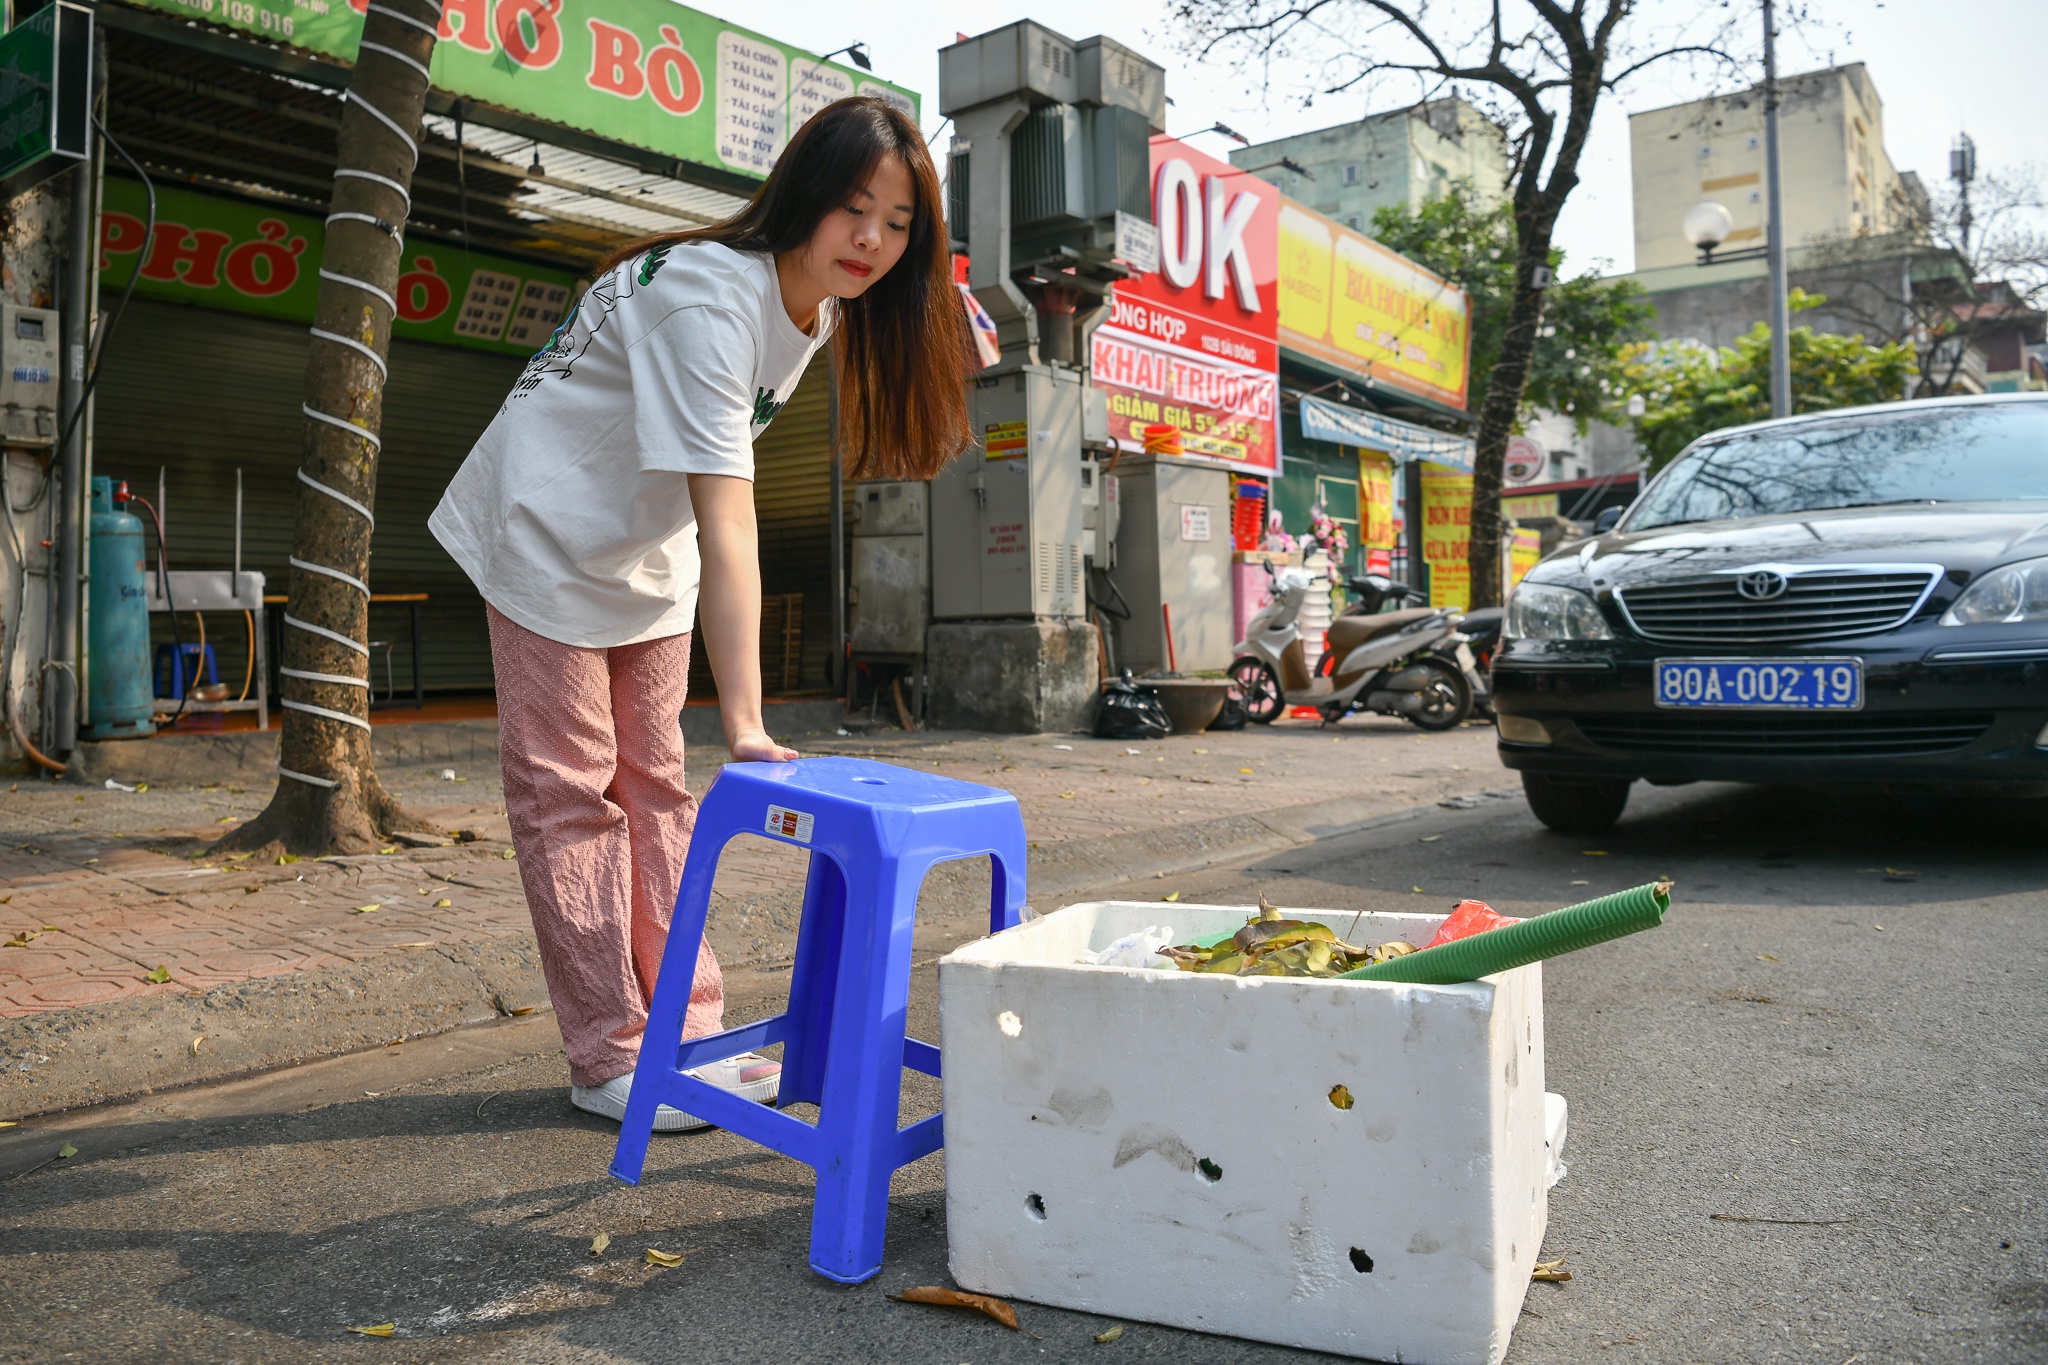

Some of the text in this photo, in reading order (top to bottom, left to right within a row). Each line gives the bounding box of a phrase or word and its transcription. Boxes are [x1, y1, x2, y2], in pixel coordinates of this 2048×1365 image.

[260, 9, 294, 36] 916
[587, 17, 704, 116] BÒ
[101, 211, 307, 298] PHỞ
[1156, 157, 1263, 314] OK
[1149, 310, 1188, 344] HỢP
[1092, 338, 1166, 396] KHAI
[1112, 392, 1160, 423] GIẢM
[1163, 405, 1193, 431] GIÁ
[1664, 666, 1851, 702] 80A-002.19
